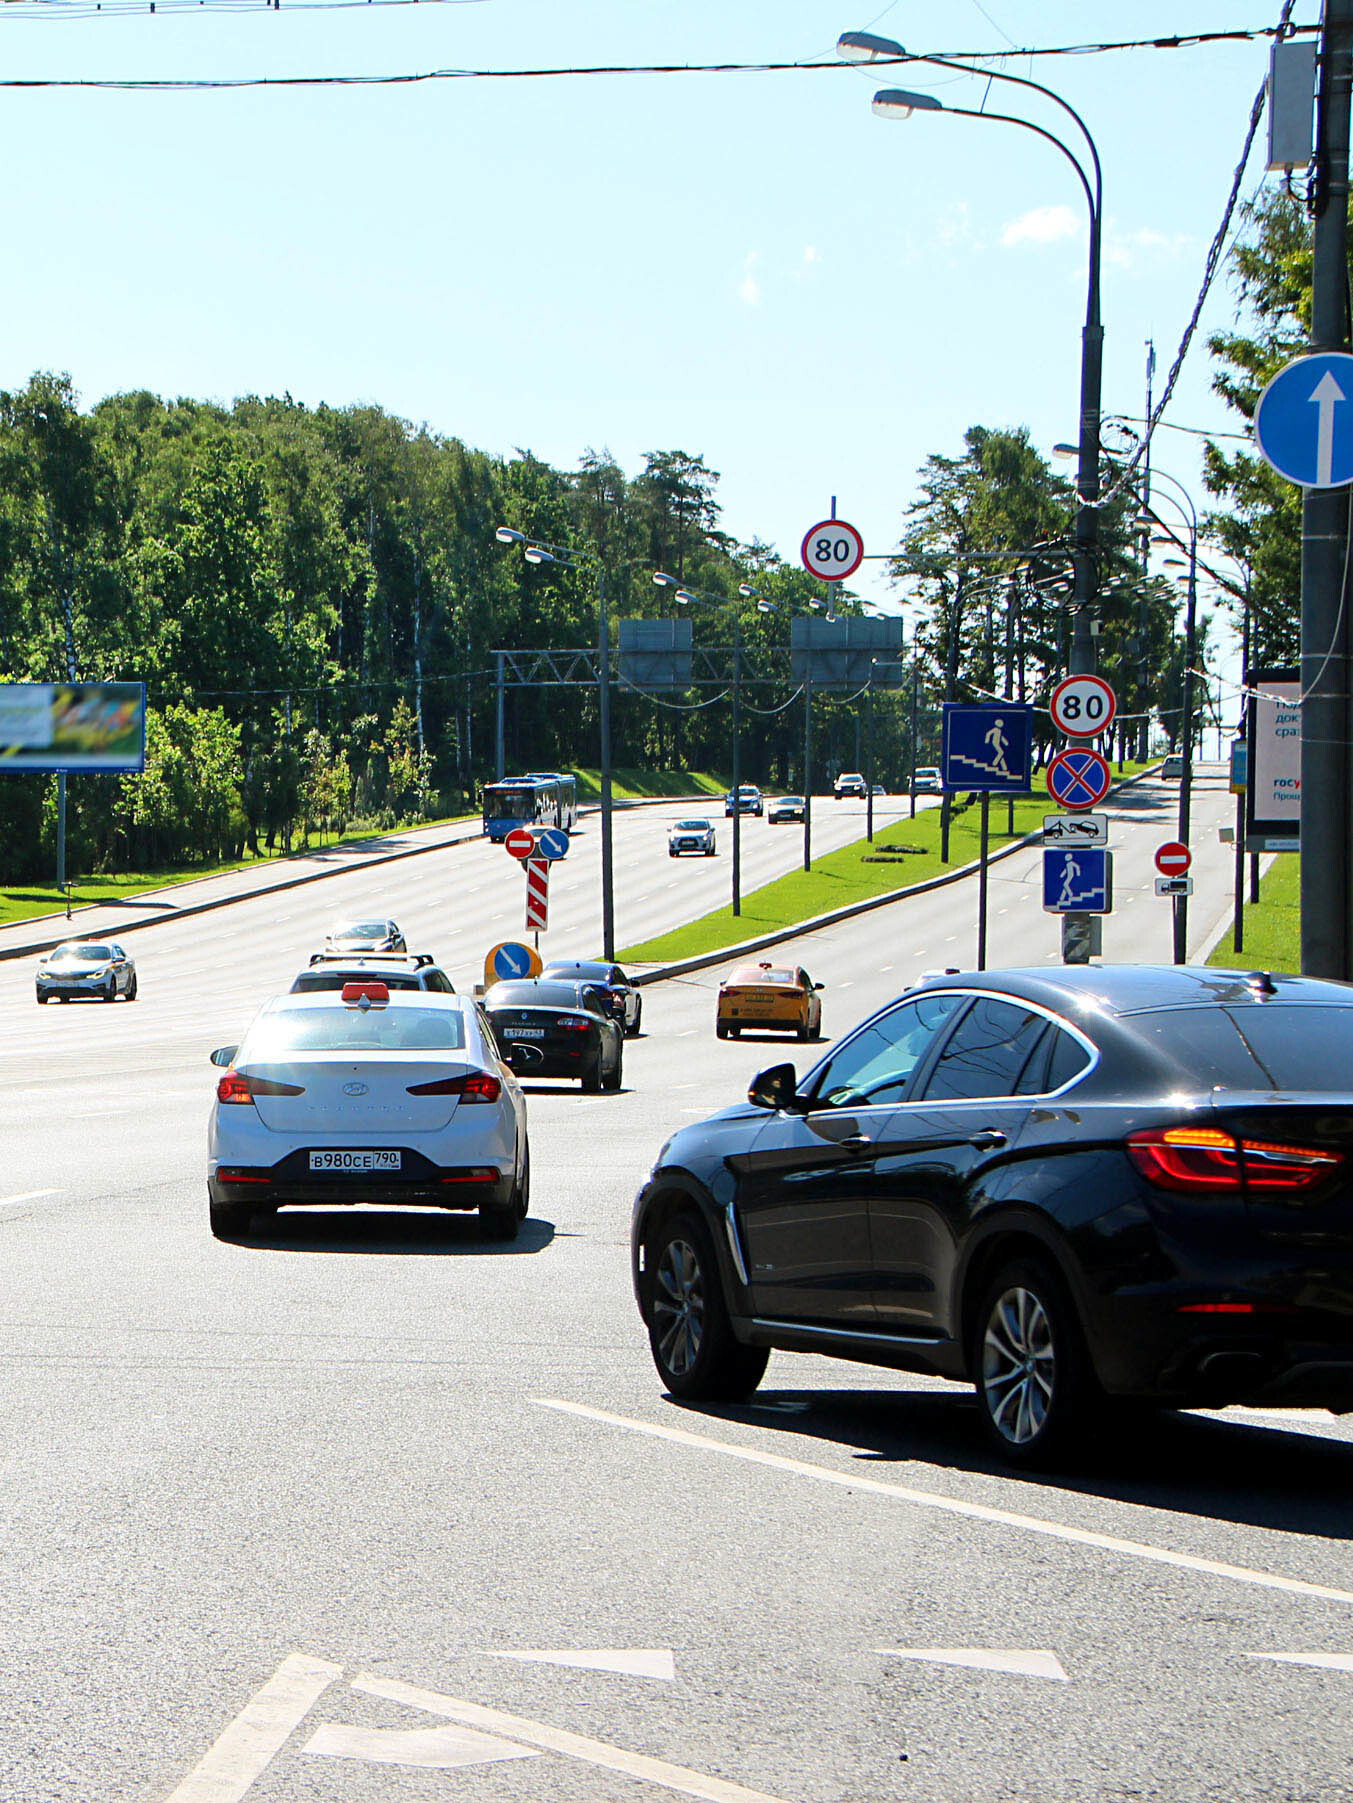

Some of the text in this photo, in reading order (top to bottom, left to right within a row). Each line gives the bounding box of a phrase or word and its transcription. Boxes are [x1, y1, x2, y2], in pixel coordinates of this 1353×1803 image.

[815, 538, 850, 563] 80
[1062, 694, 1103, 720] 80
[374, 1152, 397, 1163] 790
